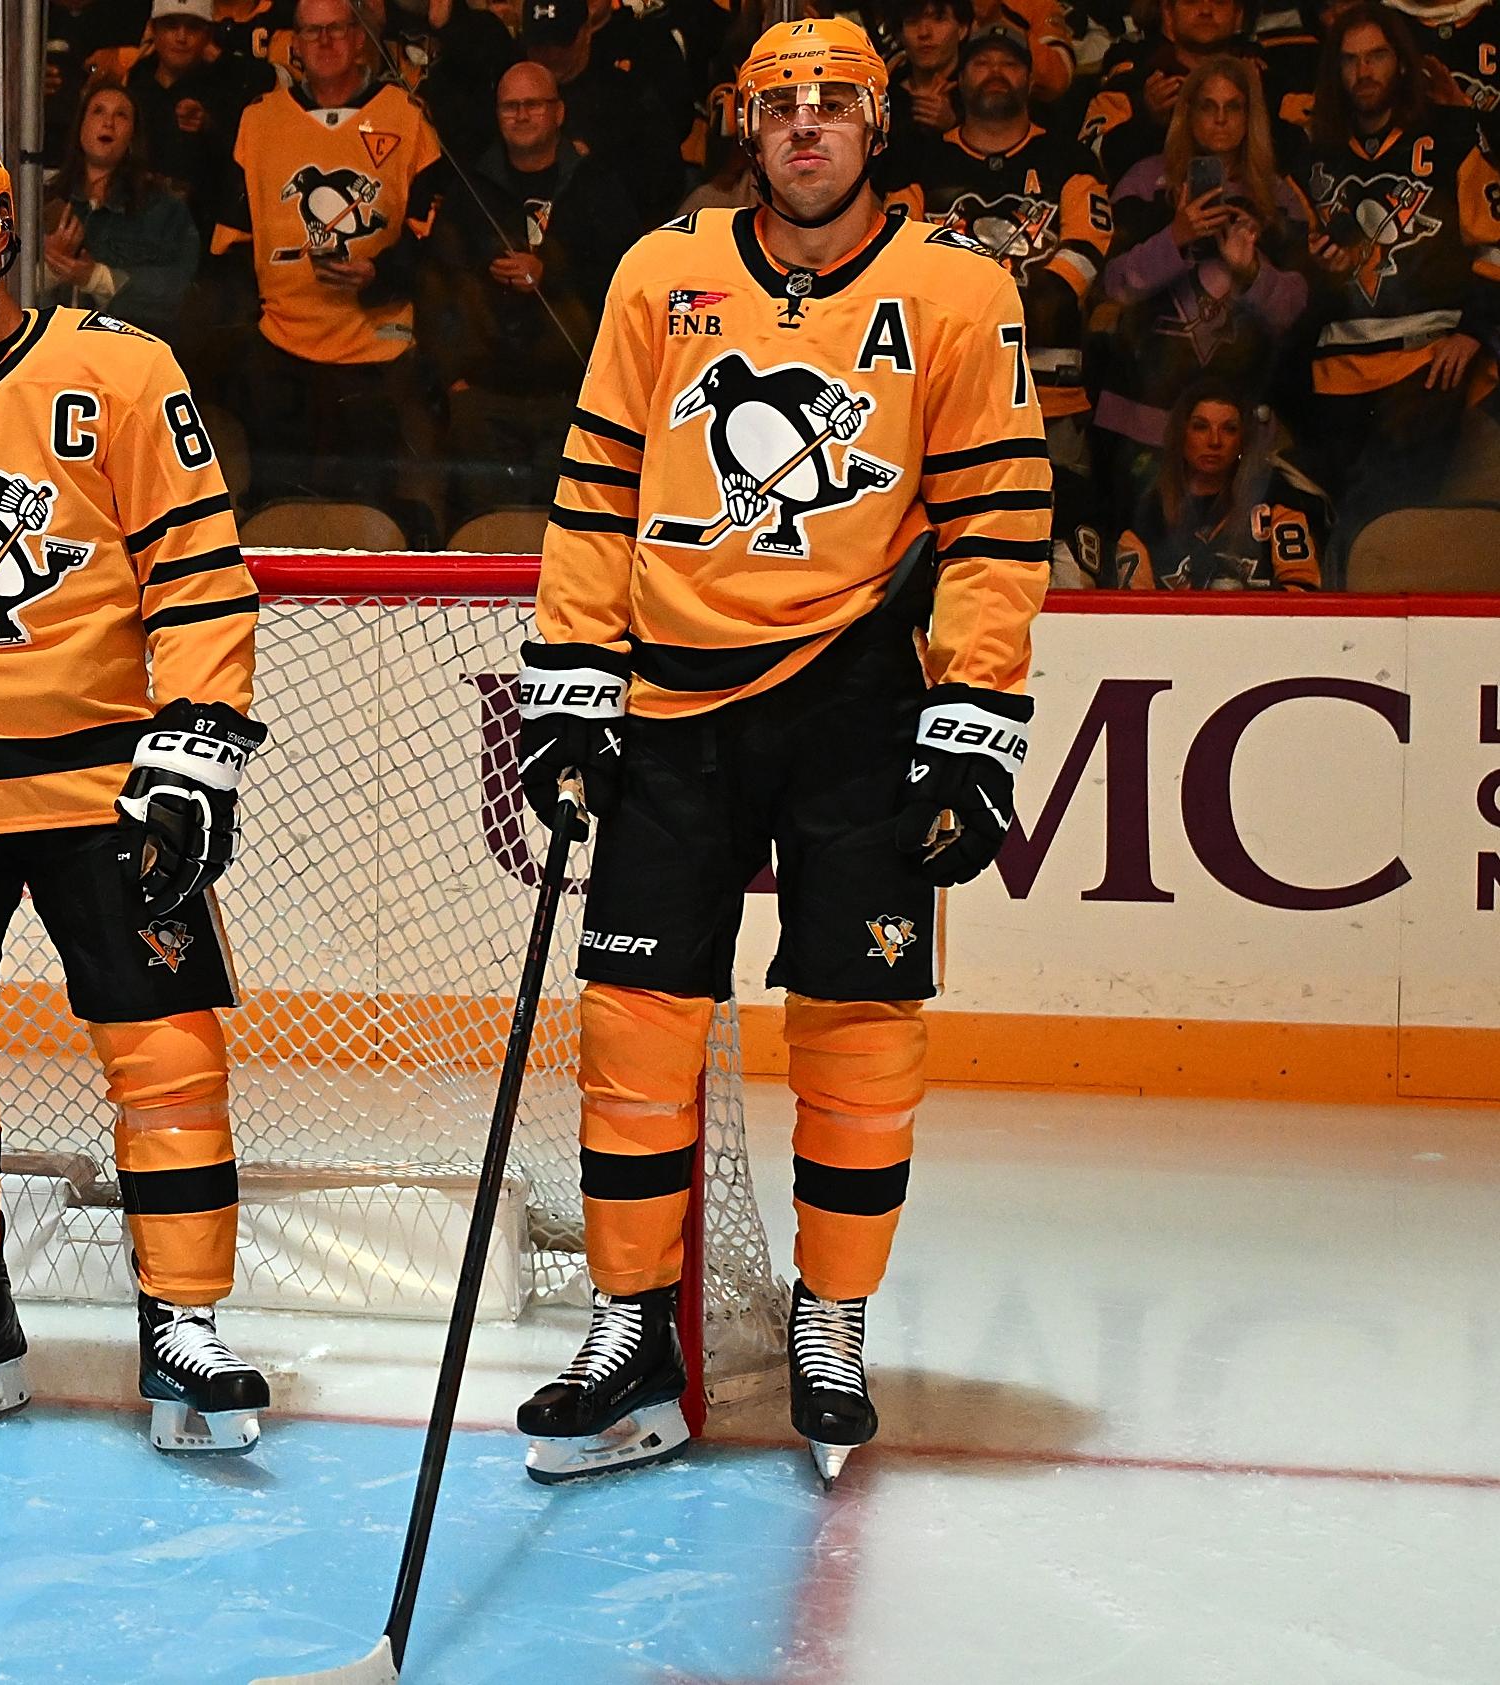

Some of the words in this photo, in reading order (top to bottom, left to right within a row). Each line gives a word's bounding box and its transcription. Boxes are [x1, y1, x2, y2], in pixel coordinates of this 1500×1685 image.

[251, 27, 268, 58] C
[791, 23, 814, 36] 71
[779, 50, 826, 61] BAUER
[1478, 42, 1498, 76] C
[375, 138, 386, 156] C
[1411, 135, 1434, 177] C
[1024, 168, 1041, 194] A
[668, 315, 723, 337] F.N.B.
[853, 298, 916, 375] A
[52, 389, 100, 461] C
[162, 389, 215, 472] 8
[1251, 503, 1272, 542] C
[1272, 521, 1311, 560] 8
[1116, 551, 1140, 589] 7
[520, 683, 622, 707] AUER
[194, 718, 216, 734] 87
[925, 717, 1028, 764] BAUE
[148, 734, 244, 772] CCM
[582, 930, 658, 956] AUER
[156, 1369, 185, 1392] CCM
